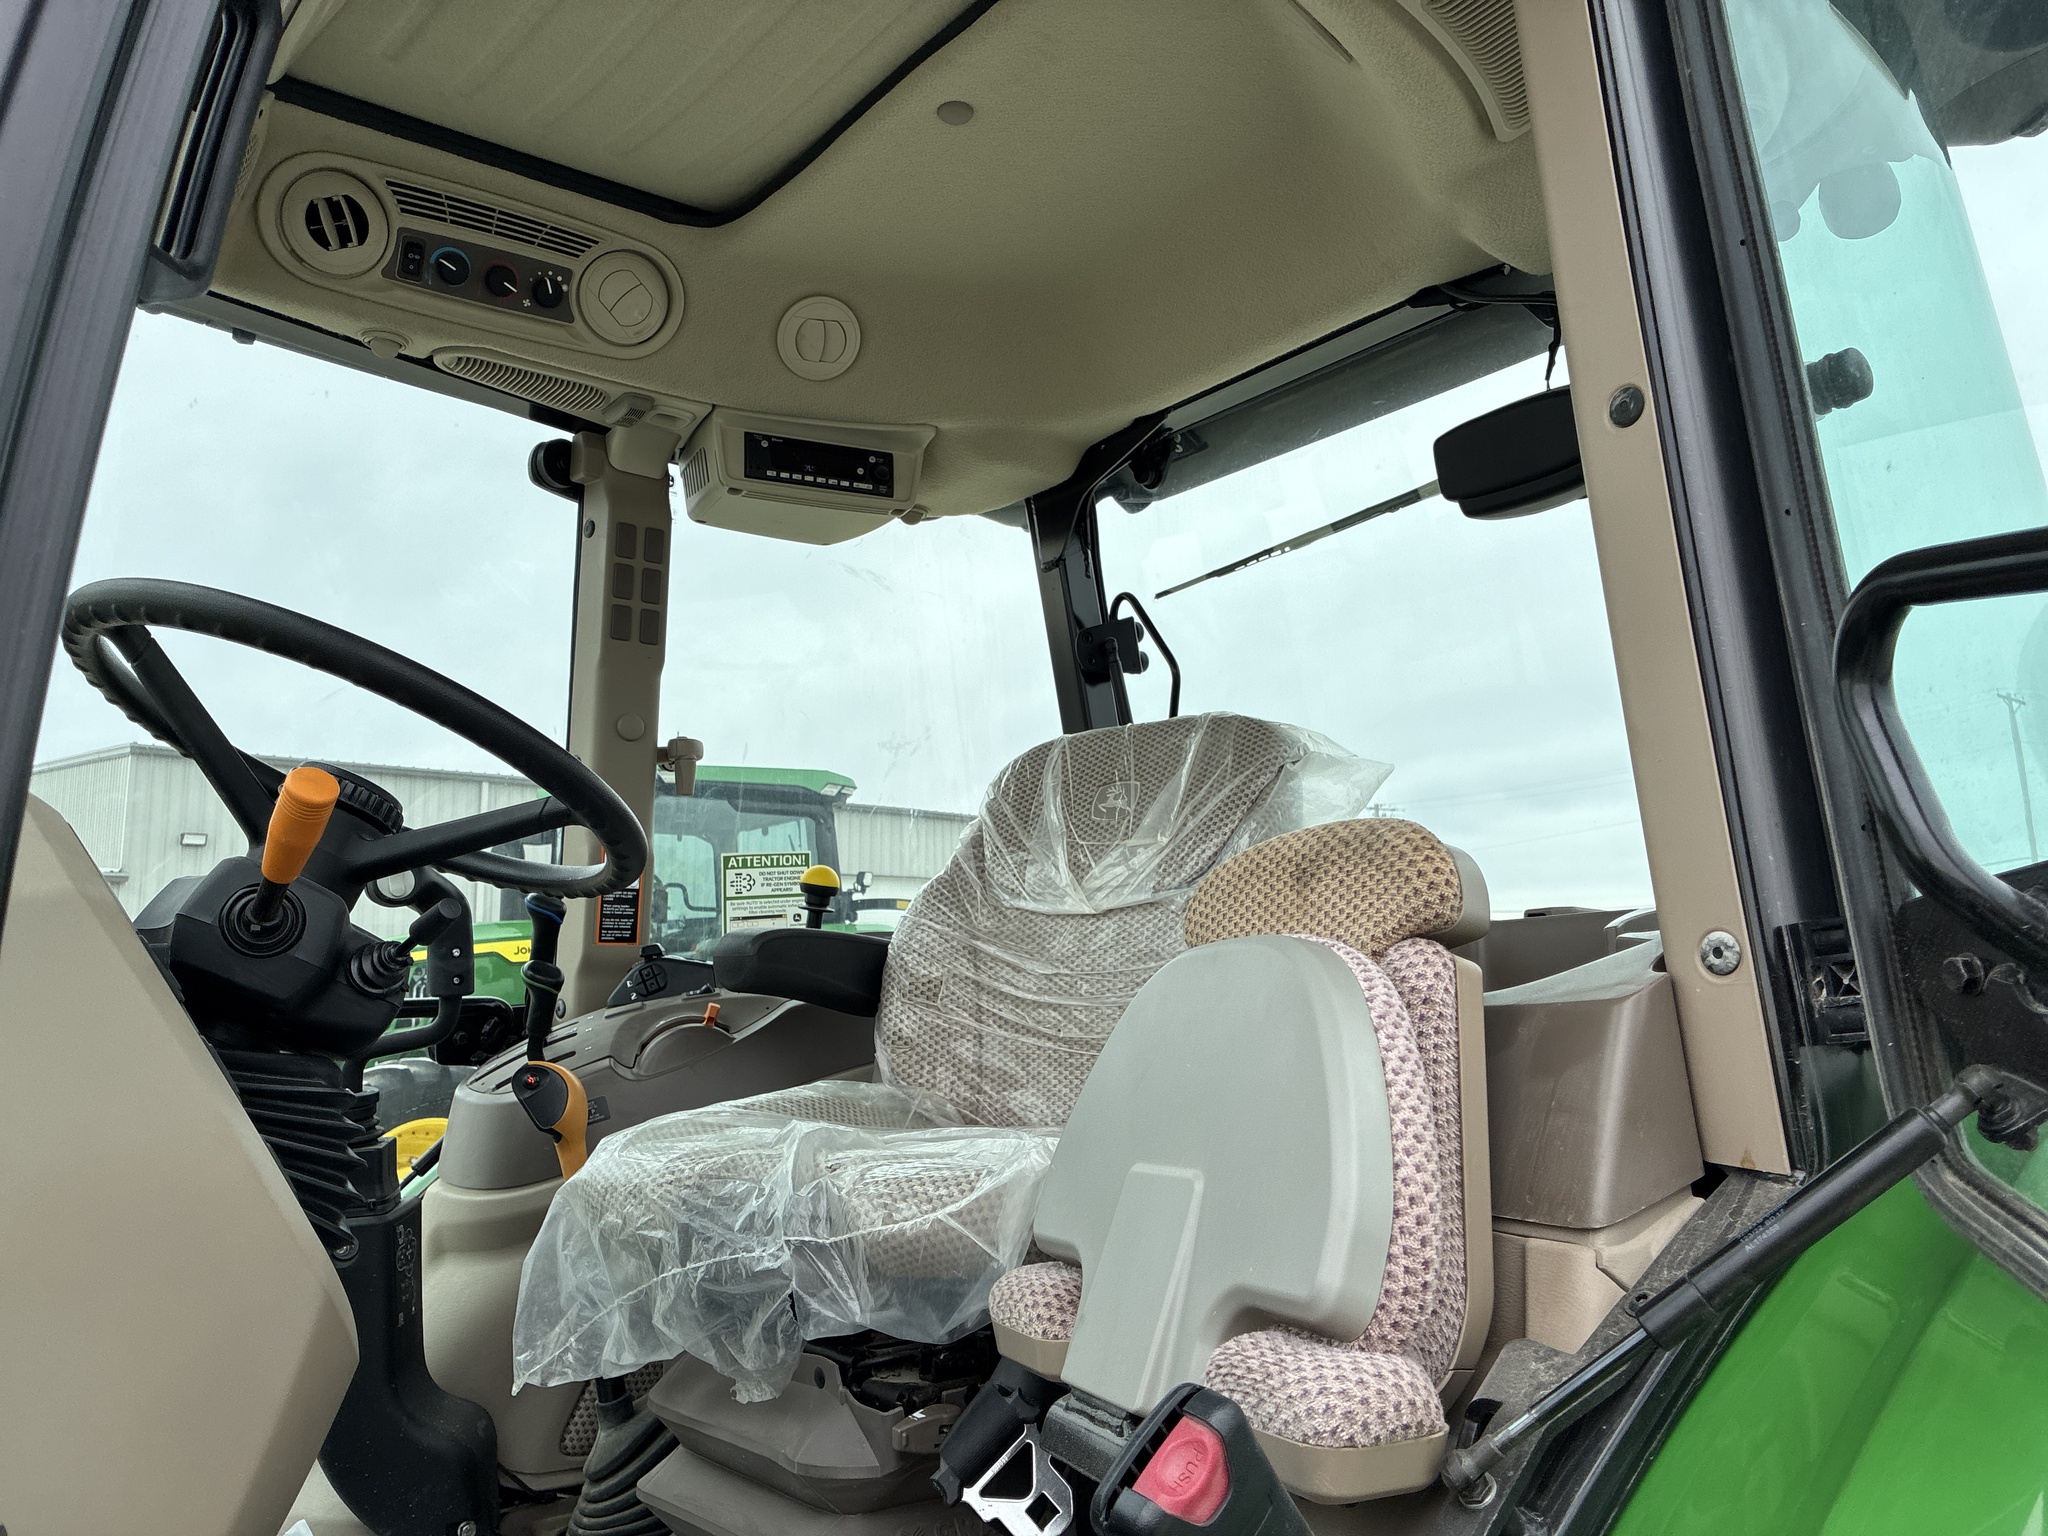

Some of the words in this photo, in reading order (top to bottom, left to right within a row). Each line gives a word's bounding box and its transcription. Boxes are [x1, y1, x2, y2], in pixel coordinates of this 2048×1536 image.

[728, 855, 806, 868] ATTENTION!
[514, 946, 531, 955] JO
[1167, 1447, 1205, 1493] PUSH
